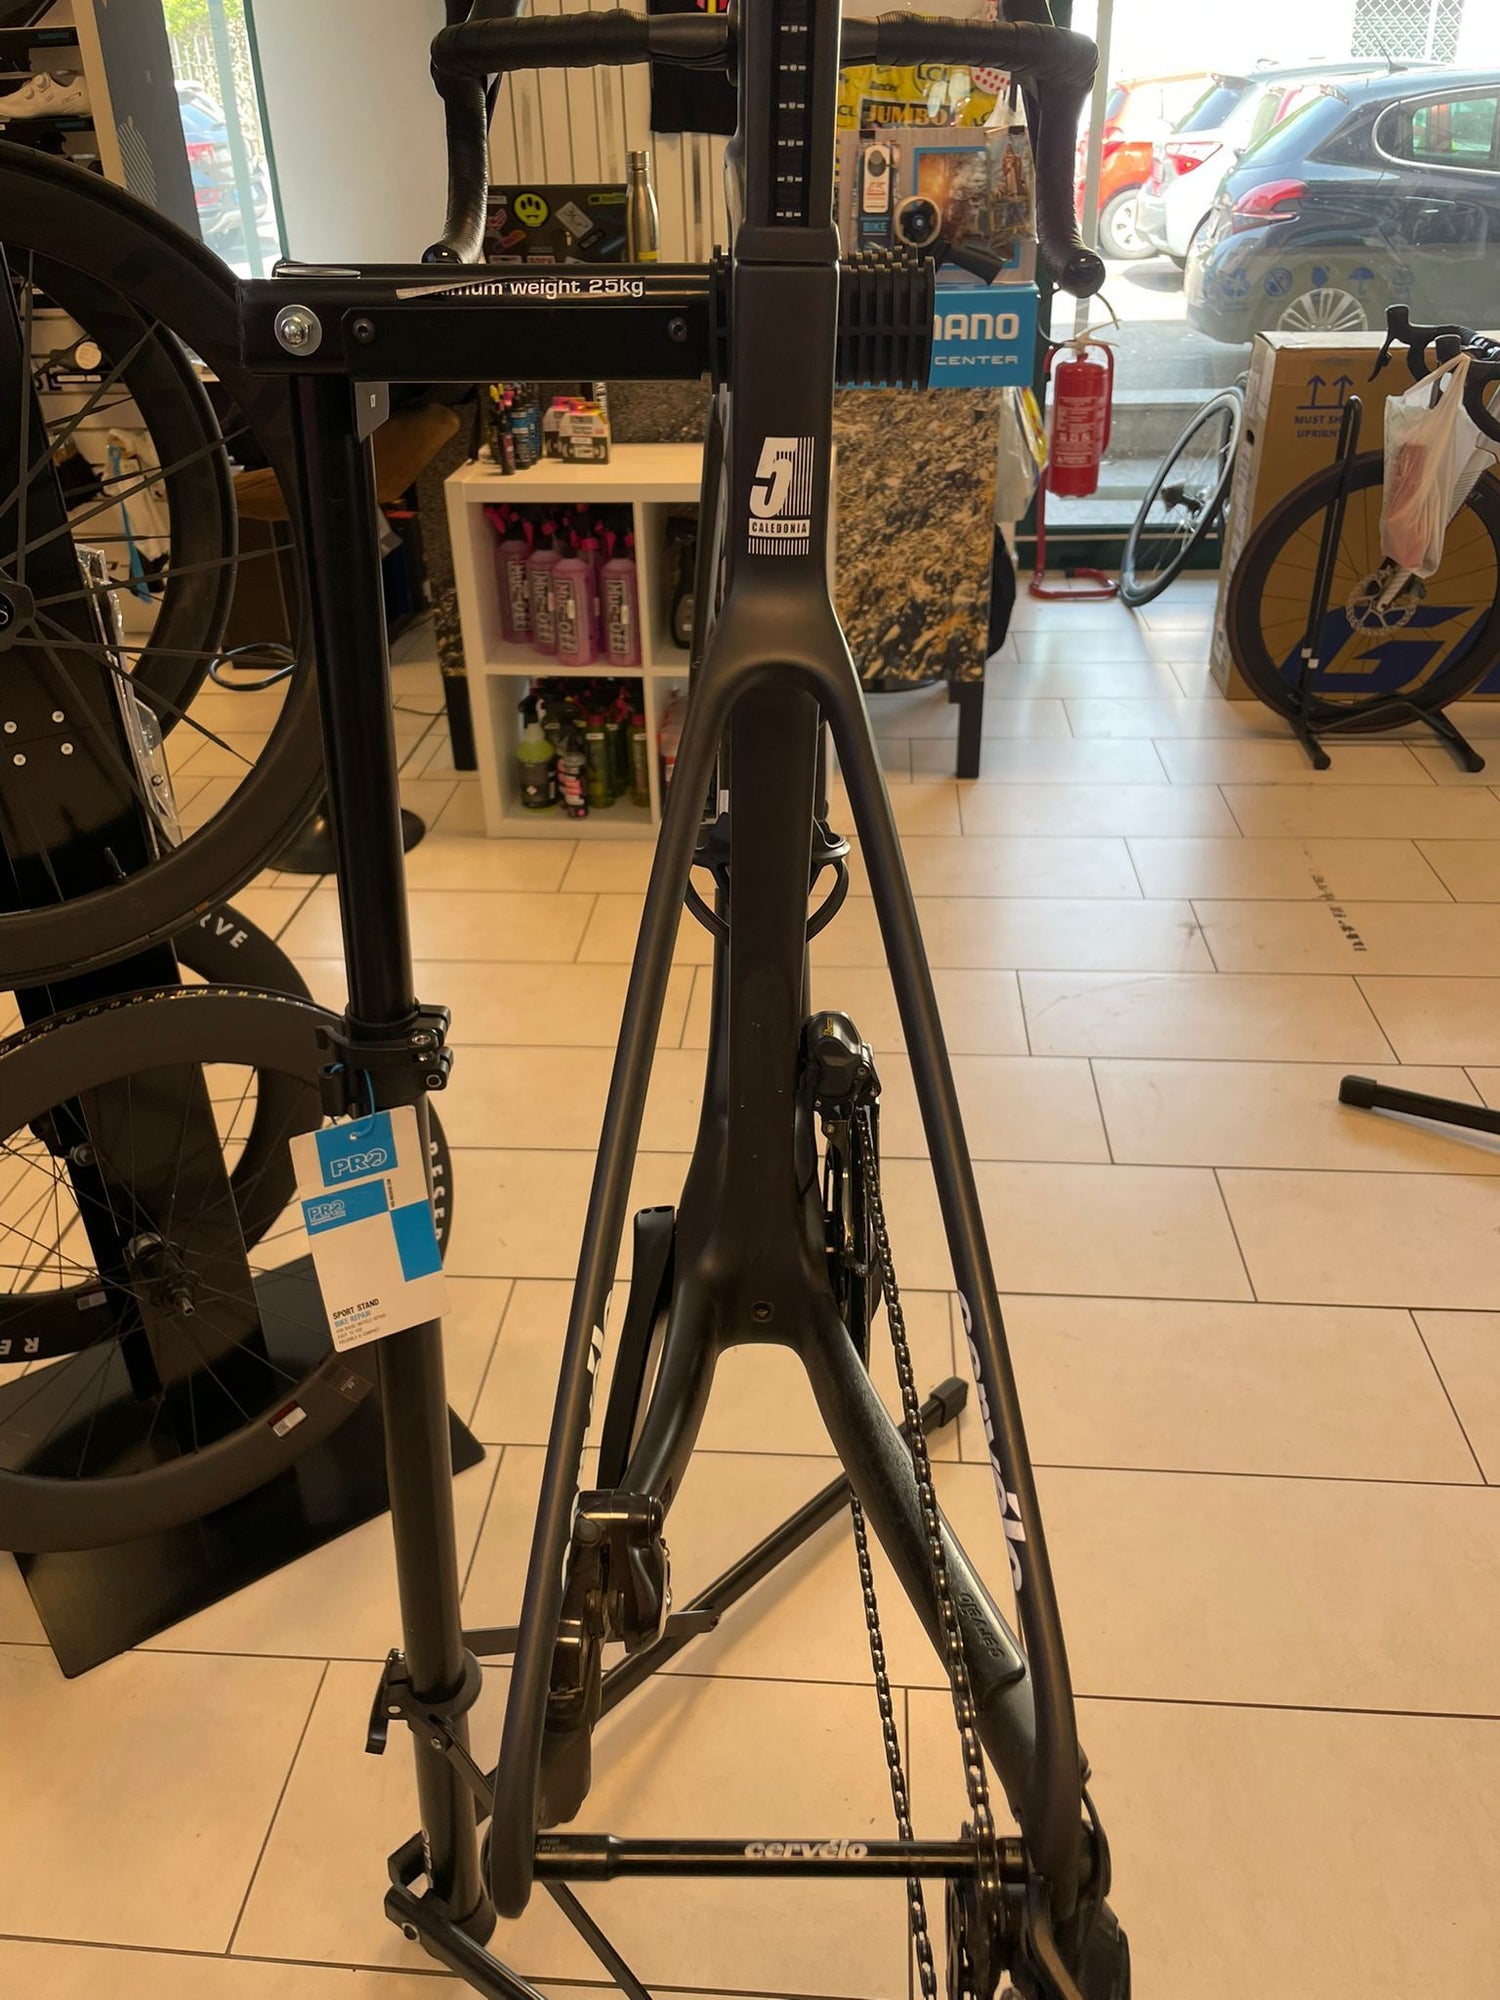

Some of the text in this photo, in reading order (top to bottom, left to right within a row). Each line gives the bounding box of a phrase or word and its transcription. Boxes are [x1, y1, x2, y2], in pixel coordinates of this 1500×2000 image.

[866, 104, 948, 126] JUMBO
[510, 279, 581, 300] weight
[588, 279, 644, 298] 25kg
[934, 355, 1018, 366] CENTER
[1294, 415, 1326, 424] MUST
[749, 437, 799, 518] 5
[751, 521, 807, 534] CALEDONIA
[330, 1147, 388, 1178] PRO
[307, 1199, 346, 1221] PRO
[332, 1298, 380, 1320] SPORT STAND
[744, 1839, 868, 1860] cervélo
